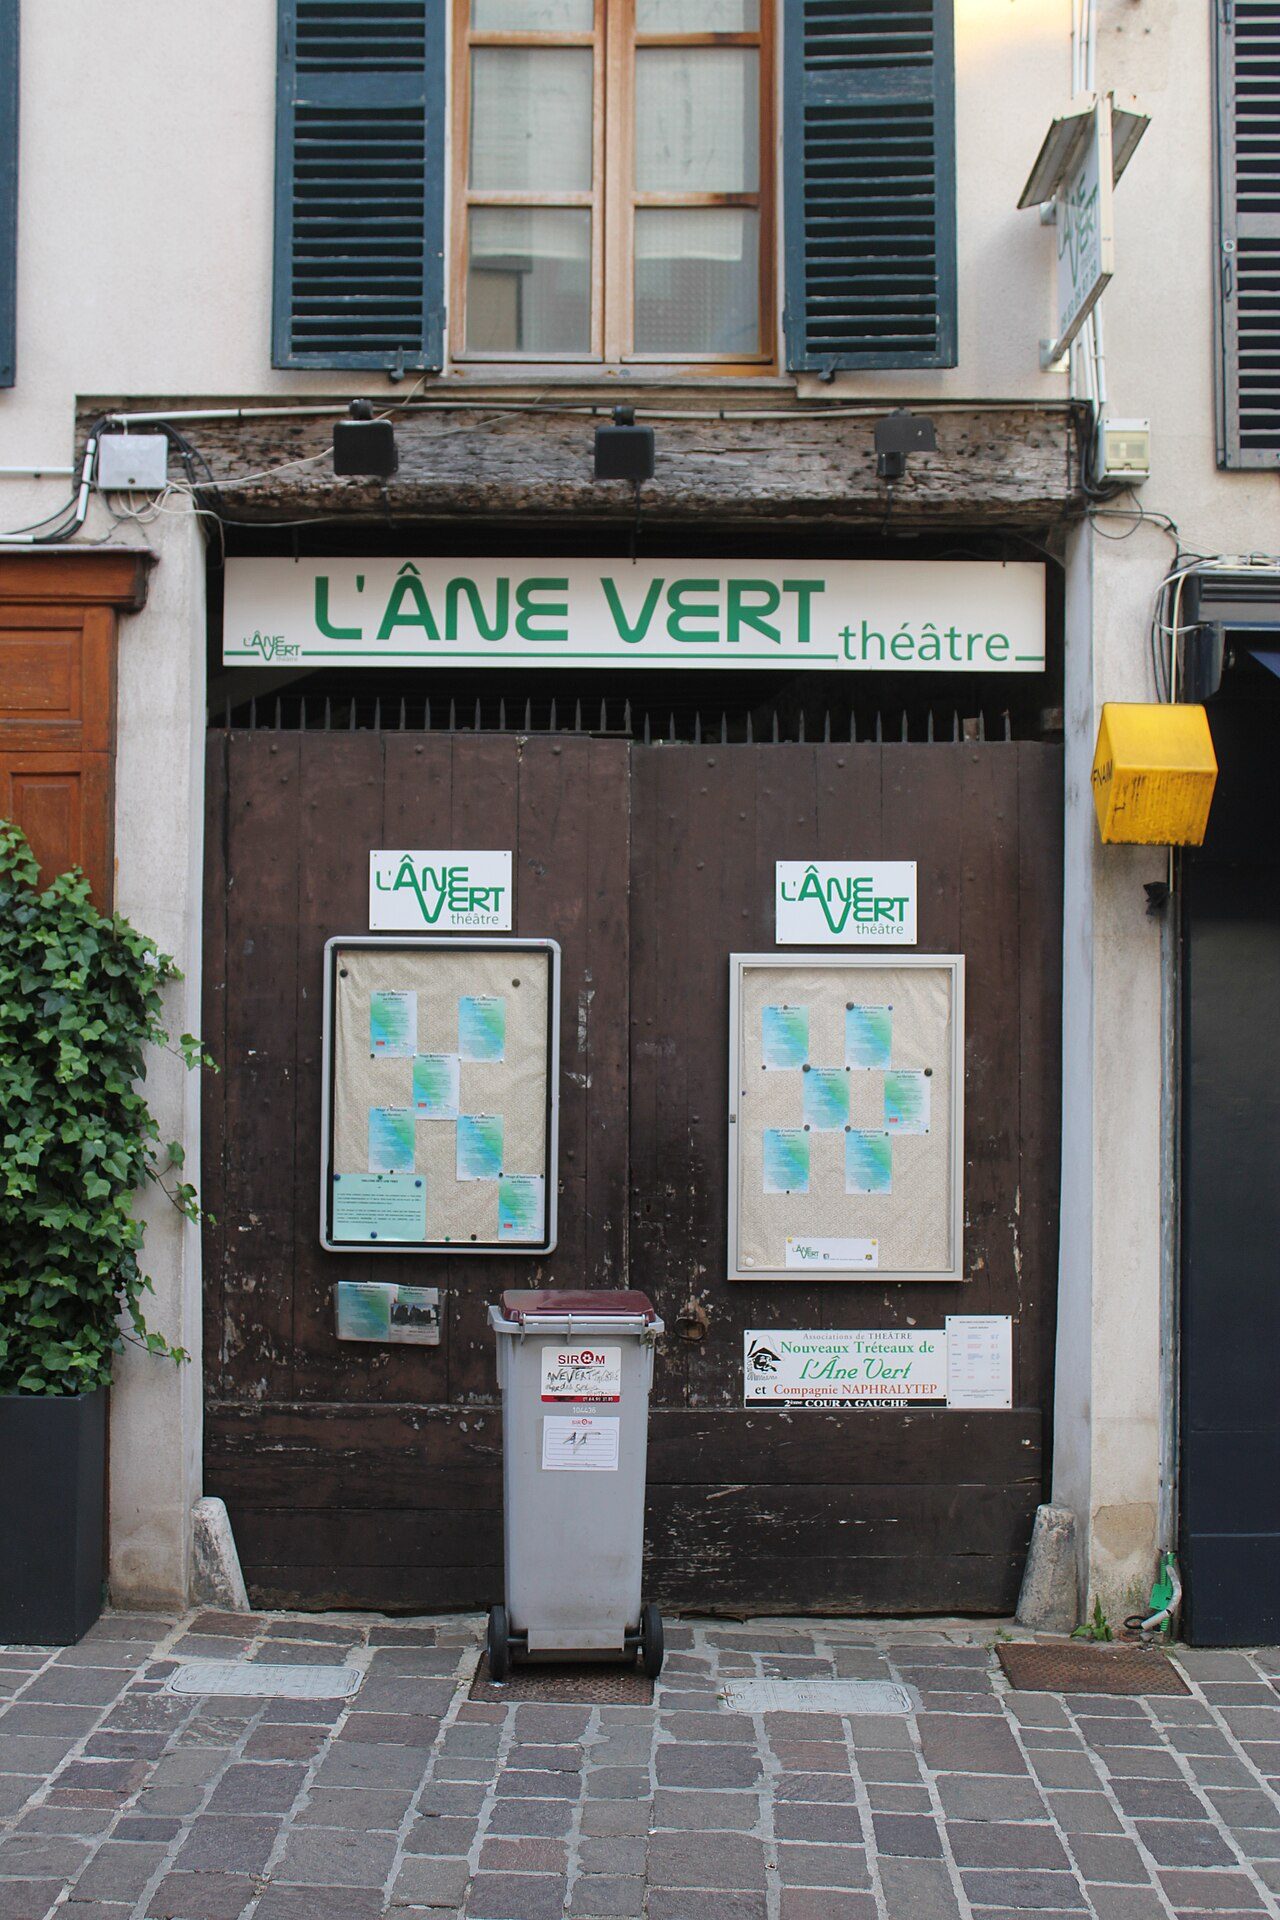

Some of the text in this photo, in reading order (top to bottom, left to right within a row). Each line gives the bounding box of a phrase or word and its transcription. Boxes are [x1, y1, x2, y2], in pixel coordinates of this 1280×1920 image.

[315, 561, 1011, 661] L'ÂNE VERT théâtre
[375, 853, 469, 892] L'ÂNE
[781, 864, 873, 902] L'ÂNE
[412, 886, 505, 924] VERT
[818, 896, 910, 934] VERT
[450, 912, 499, 925] théâtre
[855, 922, 904, 935] théâtre
[780, 1340, 935, 1354] Nouveaux Tréteaux de
[799, 1355, 913, 1380] l'Âne Vert
[754, 1383, 938, 1398] et Compagnie NAPHRALYTEP
[854, 1400, 909, 1408] GAUCHE
